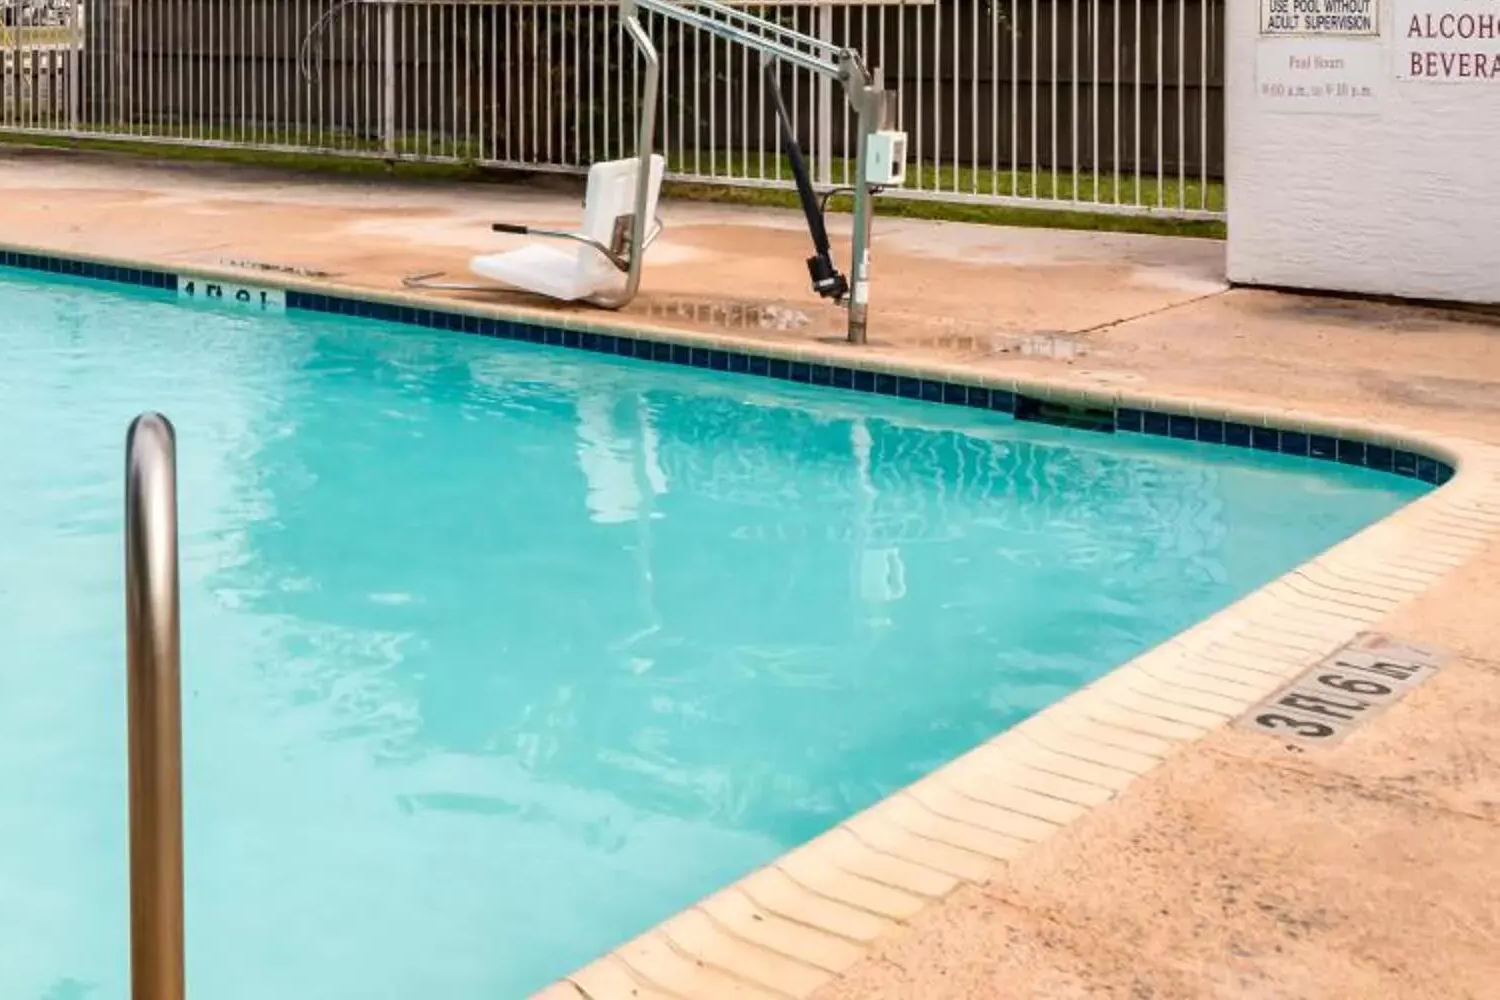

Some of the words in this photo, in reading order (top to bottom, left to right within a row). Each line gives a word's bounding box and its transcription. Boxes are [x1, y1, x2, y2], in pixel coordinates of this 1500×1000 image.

[1269, 0, 1289, 13] USE
[1293, 0, 1321, 13] POOL
[1325, 0, 1371, 13] WITHOUT
[1267, 16, 1300, 30] ADULT
[1305, 15, 1371, 30] SUPERVISION
[1407, 13, 1500, 39] ALCOH
[1255, 712, 1335, 738] 3
[1317, 674, 1393, 696] 6
